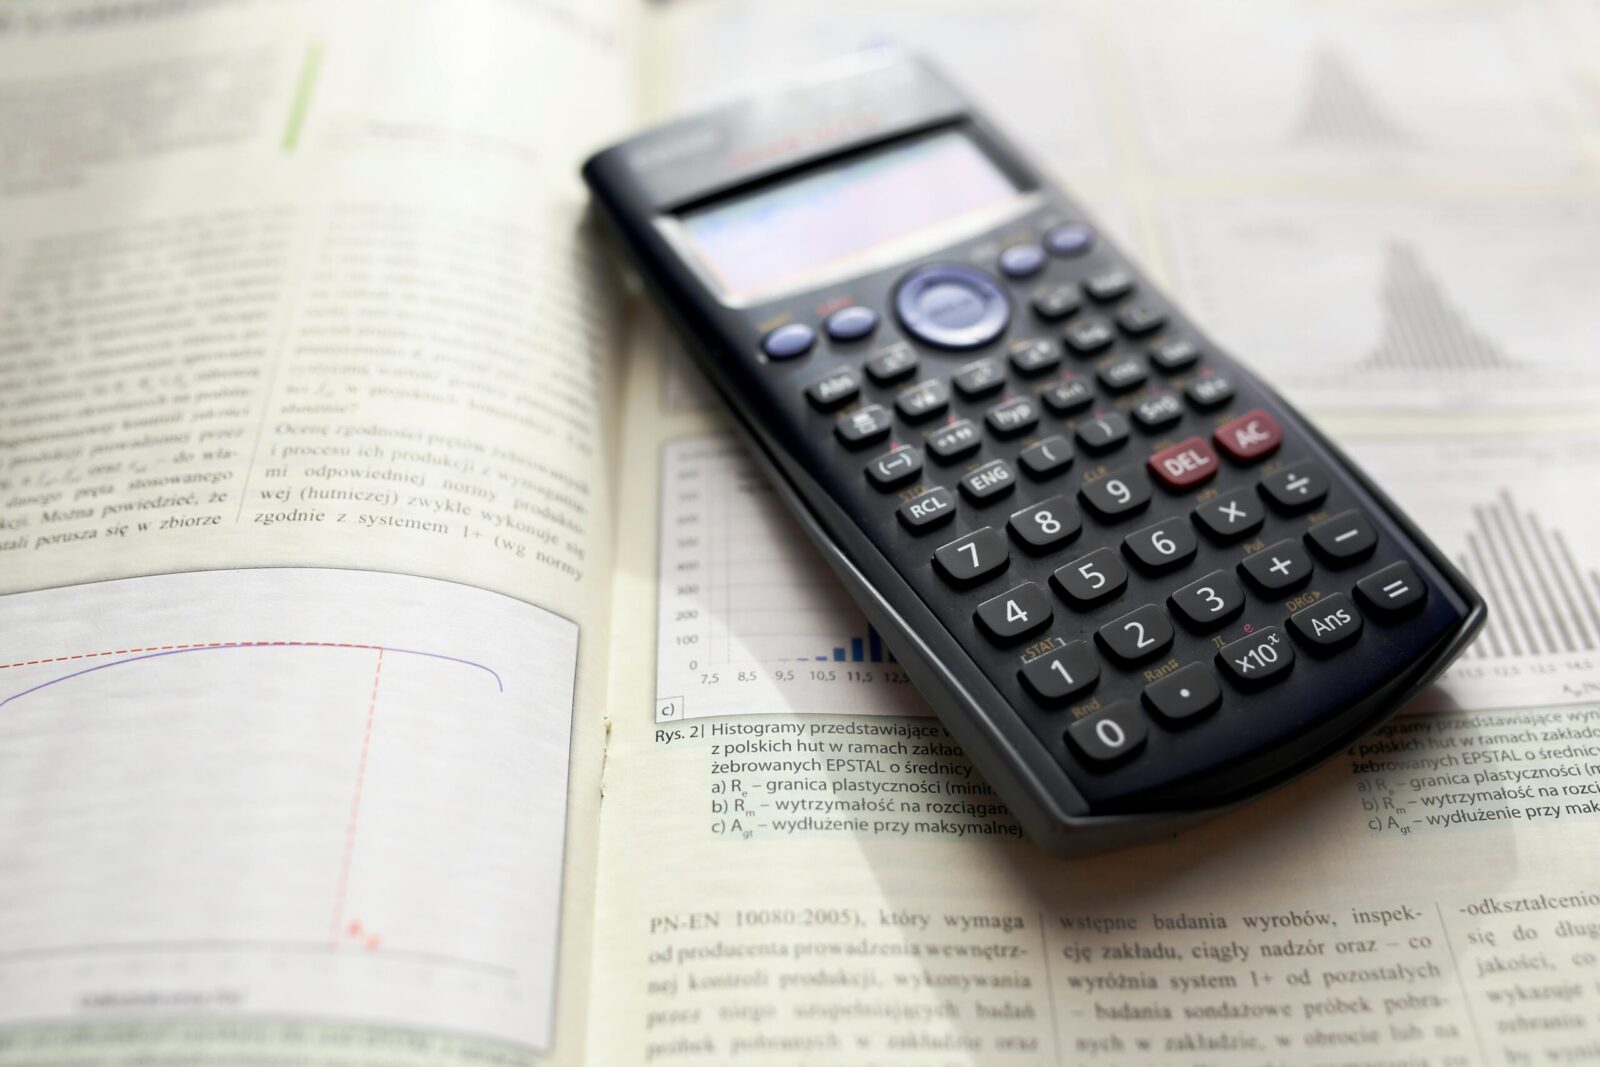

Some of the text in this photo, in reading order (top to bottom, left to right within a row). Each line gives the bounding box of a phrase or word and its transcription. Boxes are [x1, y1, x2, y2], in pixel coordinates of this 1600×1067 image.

[1235, 421, 1270, 449] AC
[282, 446, 350, 459] procesu
[358, 444, 384, 458] ich
[1164, 449, 1210, 477] DEL
[128, 470, 233, 491] stosowanego
[265, 464, 497, 502] mi odpowiedniej normy
[970, 466, 1010, 490] ENG
[1106, 479, 1131, 504] 9
[102, 493, 199, 518] powiedzieć,
[208, 491, 227, 504] że
[260, 486, 292, 503] wej
[300, 486, 398, 506] (hutniczej)
[408, 495, 472, 517] zwykle
[481, 509, 560, 546] wykonuje
[910, 496, 947, 518] RCL
[35, 513, 222, 549] porusza się w zbiorze
[1034, 510, 1061, 534] 8
[254, 508, 584, 582] zgodnie z systemem 1+ (wg normy
[957, 542, 980, 568] 7
[1151, 530, 1176, 555] 6
[1078, 562, 1106, 590] 5
[1006, 599, 1029, 623] 4
[1196, 587, 1225, 612] 3
[675, 609, 699, 622] 200
[1311, 608, 1351, 637] Ans
[675, 634, 699, 646] 100
[1123, 621, 1155, 649] 2
[689, 660, 698, 671] 0
[700, 673, 720, 686] 7,5
[737, 670, 757, 683] 8,5
[775, 670, 795, 683] 9,5
[809, 670, 836, 683] 10,5
[847, 670, 873, 683] 11,5
[1050, 659, 1074, 685] 1
[1144, 659, 1179, 682] Ran#
[661, 703, 675, 718] c)
[1071, 698, 1100, 719] Rnd
[711, 722, 805, 738] Histogramy
[810, 722, 939, 740] przedstawiające
[1095, 718, 1125, 748] 0
[1437, 711, 1562, 734] przedstawiające
[655, 730, 685, 745] Rys.
[711, 740, 907, 757] z polskich hut w ramach
[1429, 735, 1456, 750] hut
[1460, 737, 1474, 748] w
[1478, 729, 1538, 745] ramach
[711, 758, 973, 778] żebrowanych EPSTAL o średnicy
[1352, 749, 1536, 775] żebrowanych EPSTAL o
[711, 780, 726, 795] a)
[767, 778, 827, 795] granica
[832, 778, 940, 795] plastyczności
[1358, 779, 1373, 793] a)
[1410, 772, 1470, 791] granica
[1475, 763, 1581, 786] plastyczności
[711, 799, 728, 814] b)
[776, 797, 895, 814] wytrzymałość
[901, 801, 920, 812] na
[927, 800, 1011, 818] rozciągan
[1362, 796, 1379, 812] b)
[1421, 784, 1535, 809] wytrzymałość
[1538, 786, 1559, 798] na
[711, 820, 726, 834] c)
[772, 816, 868, 834] wydłużenie
[874, 819, 909, 836] przy
[915, 819, 1023, 838] maksymalnej
[1368, 817, 1383, 832] c)
[1426, 805, 1521, 827] wydłużenie
[1525, 804, 1560, 821] przy
[650, 908, 1024, 933] PN-EN 10080:2005), który wymaga
[1060, 904, 1423, 934] wstępne badania wyrobów, inspek-
[1467, 923, 1538, 947] się do
[649, 944, 672, 964] od
[1102, 942, 1183, 960] zakładu,
[1192, 940, 1249, 963] ciągły
[1260, 938, 1325, 958] nadzór
[1335, 939, 1378, 955] oraz
[1408, 935, 1432, 949] co
[1170, 974, 1237, 994] system
[1286, 967, 1312, 986] od
[1322, 961, 1441, 989] pozostałych
[1477, 951, 1557, 979] jakości,
